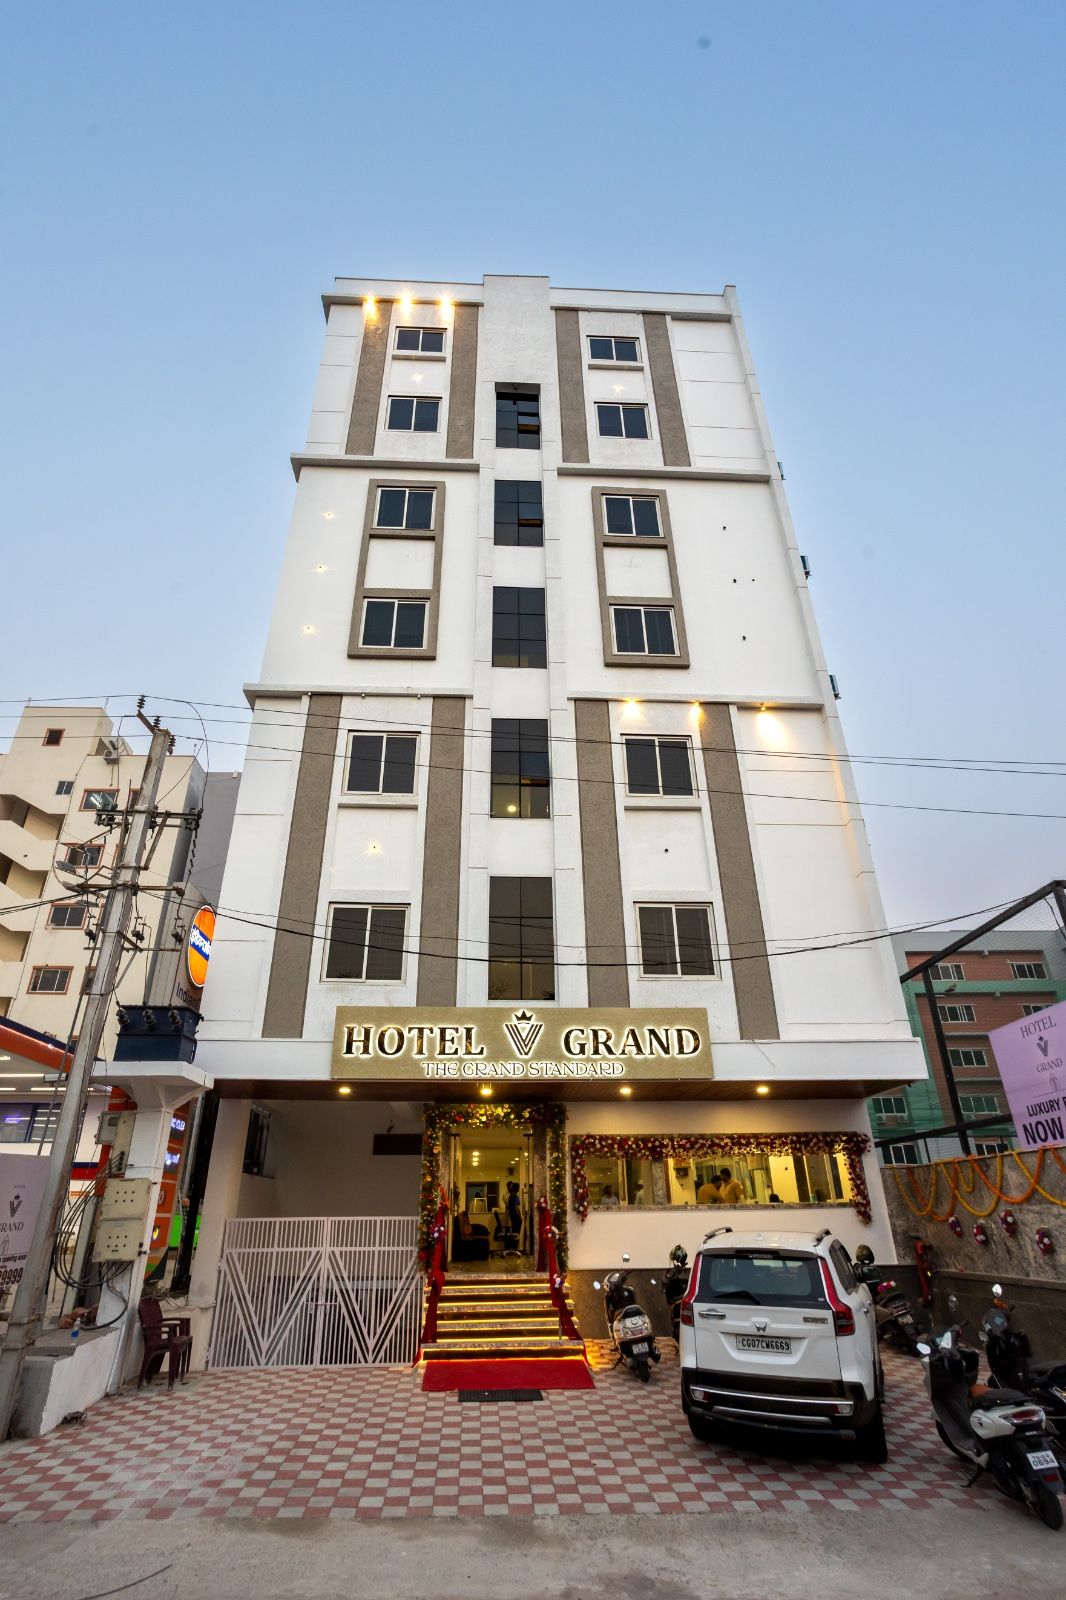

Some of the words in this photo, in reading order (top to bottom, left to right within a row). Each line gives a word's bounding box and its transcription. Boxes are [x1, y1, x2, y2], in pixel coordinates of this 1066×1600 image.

[1020, 1015, 1057, 1038] HOTEL
[343, 1026, 485, 1056] HOTEL
[563, 1028, 701, 1056] GRAND
[421, 1062, 459, 1076] THE
[462, 1062, 526, 1076] GRAND
[529, 1062, 624, 1076] STANDARD
[1036, 1057, 1063, 1073] GRAND
[1026, 1097, 1061, 1117] LUXURY
[1022, 1116, 1065, 1145] NOW
[741, 1338, 790, 1351] CG07CW6669
